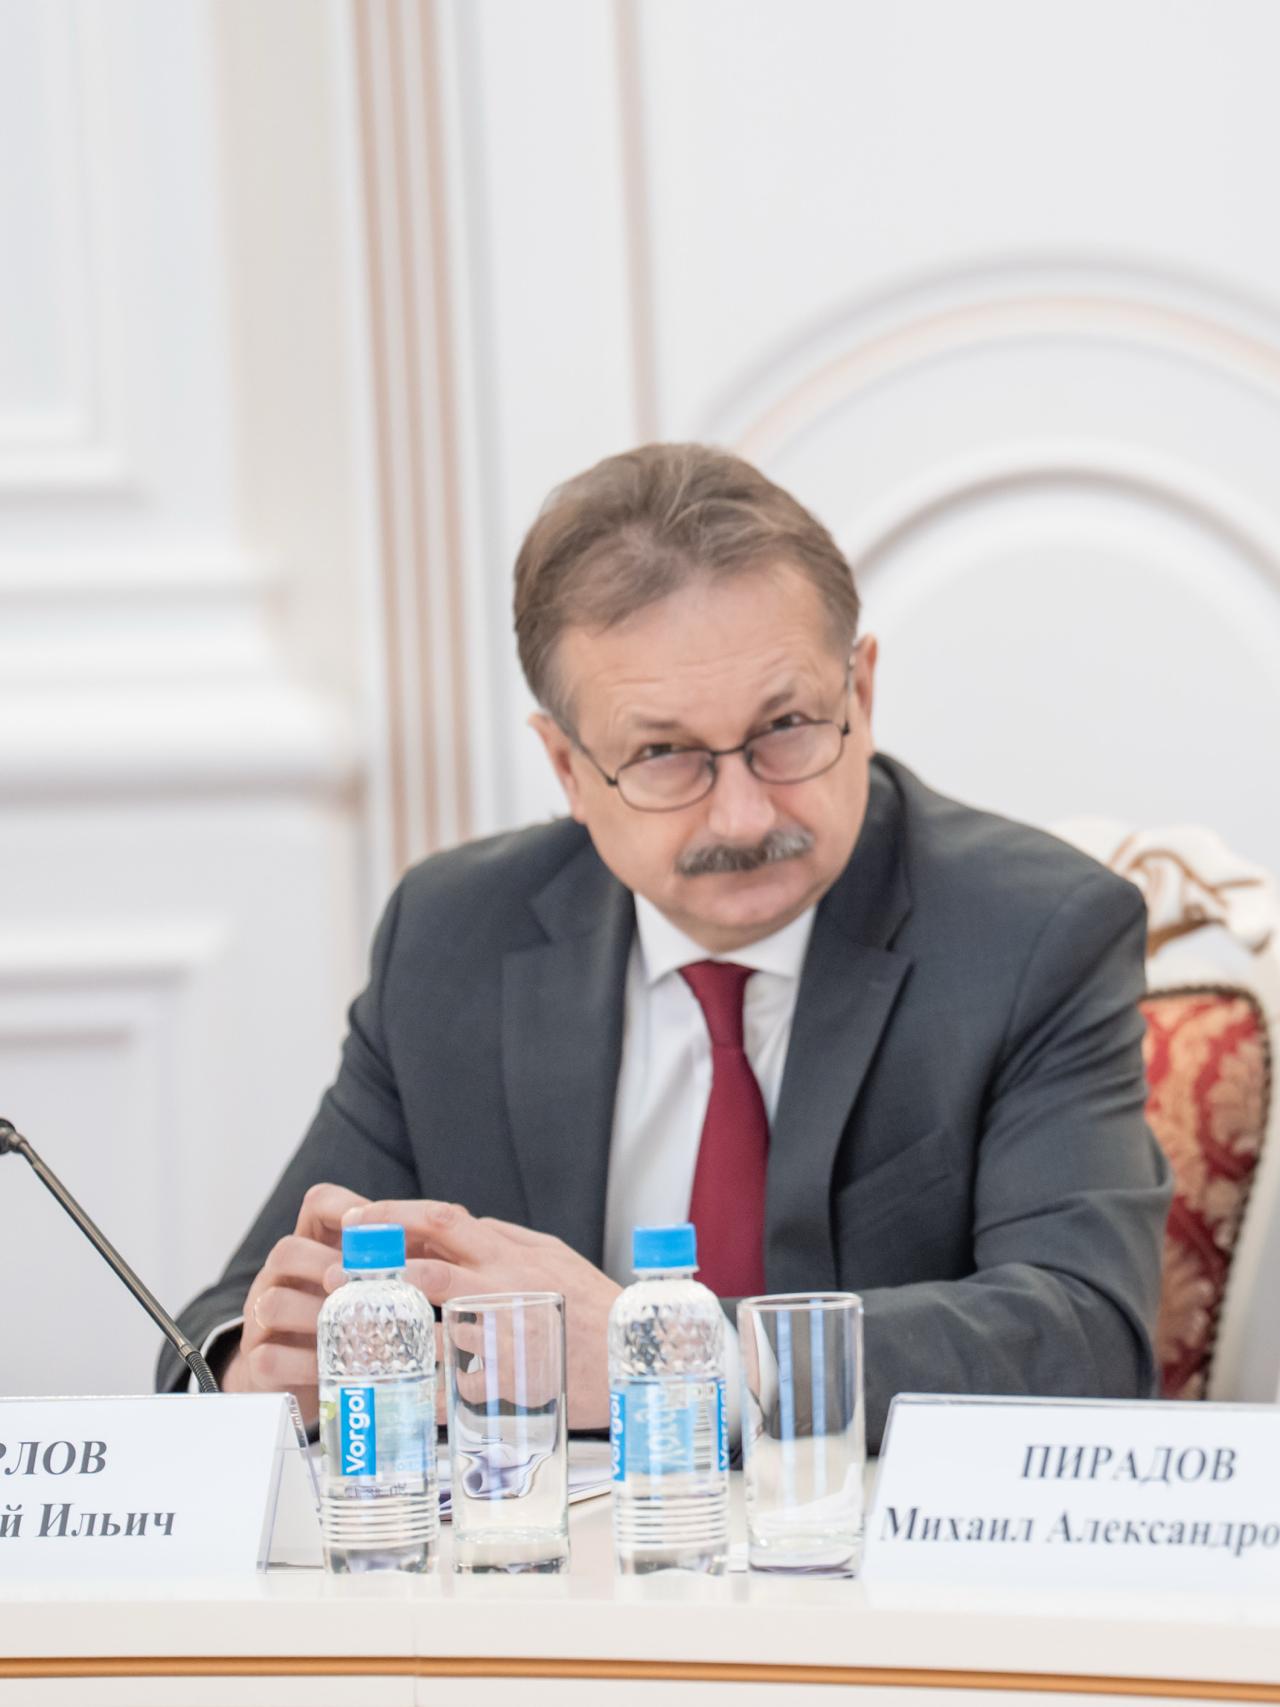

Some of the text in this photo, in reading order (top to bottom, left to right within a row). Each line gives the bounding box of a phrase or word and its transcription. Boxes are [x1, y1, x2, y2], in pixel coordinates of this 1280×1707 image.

[344, 1389, 371, 1474] Vorgol
[0, 1440, 108, 1476] ЛОВ
[1019, 1444, 1238, 1484] ПИРАДОВ
[35, 1503, 176, 1538] Ильич
[879, 1506, 1035, 1544] Михаил
